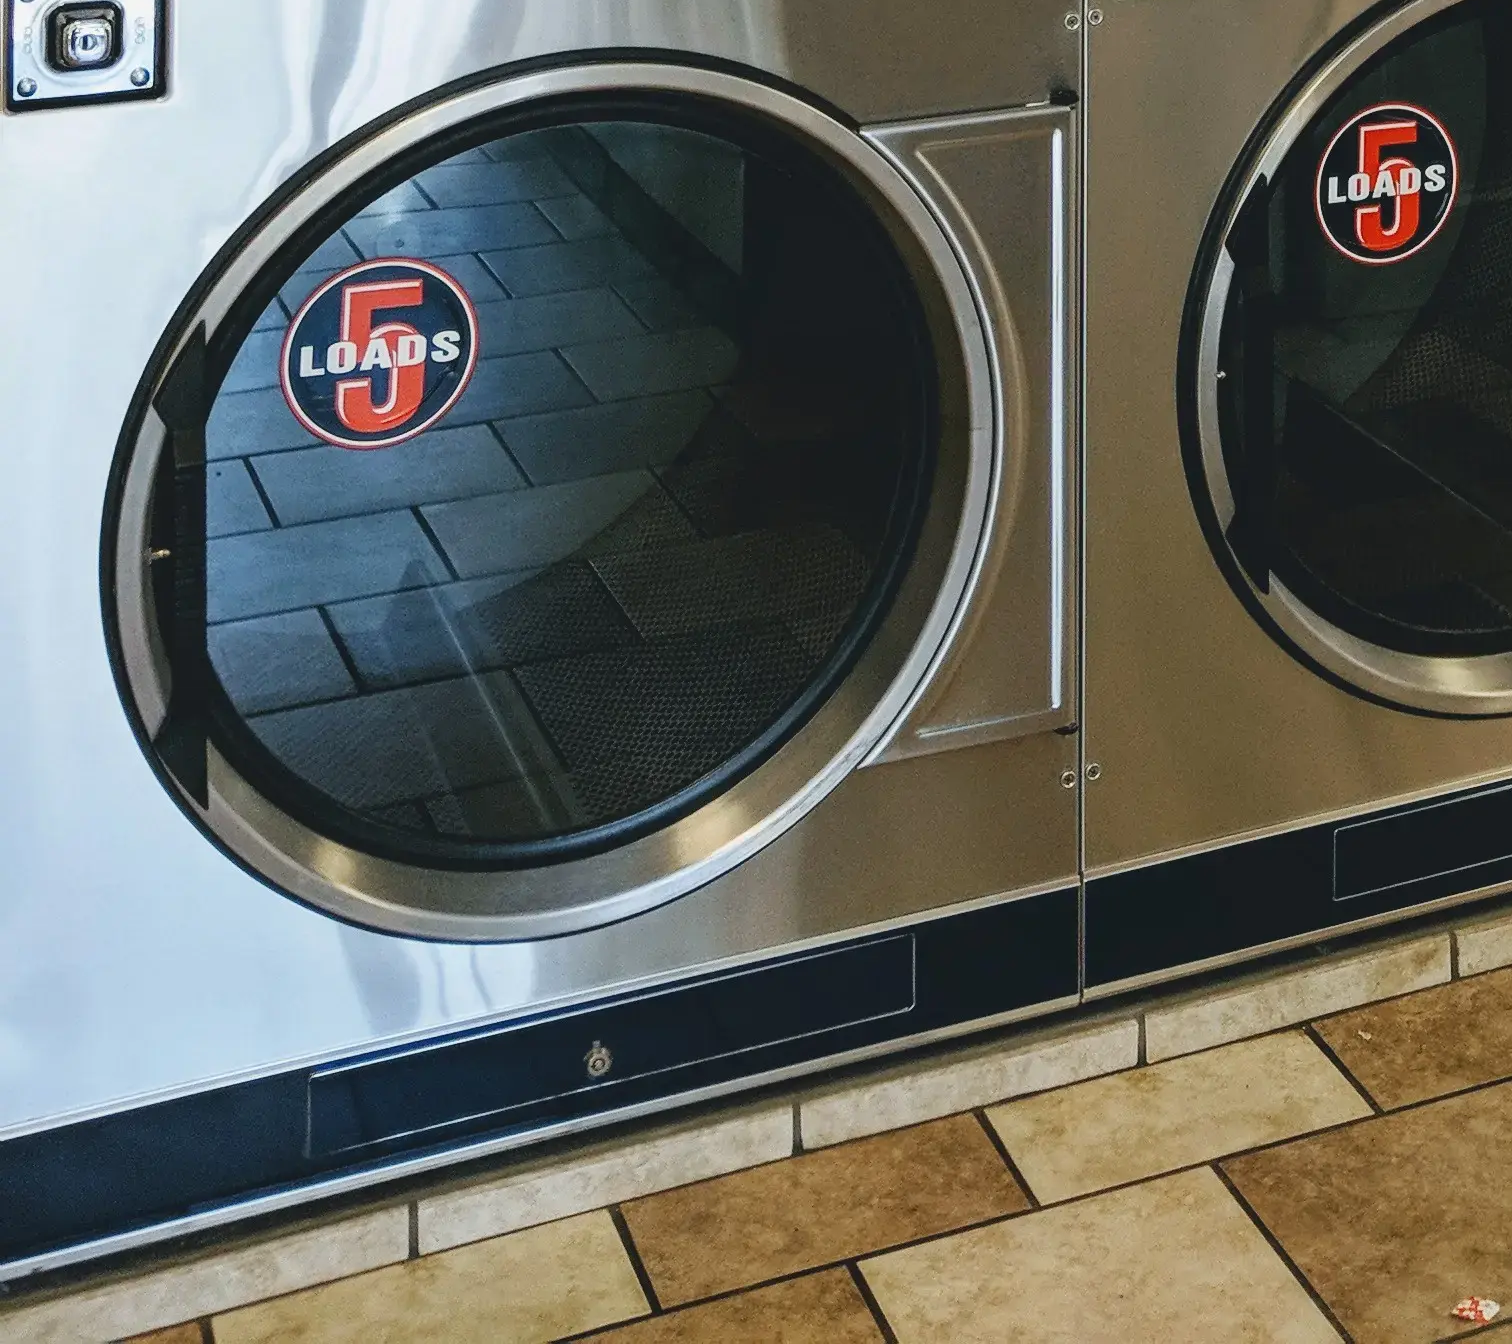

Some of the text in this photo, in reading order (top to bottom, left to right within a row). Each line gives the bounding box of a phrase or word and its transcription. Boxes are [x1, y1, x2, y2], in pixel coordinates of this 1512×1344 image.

[1327, 164, 1446, 204] LOADS
[1355, 120, 1421, 251] 5
[299, 330, 461, 378] LOADS
[335, 278, 426, 433] 5
